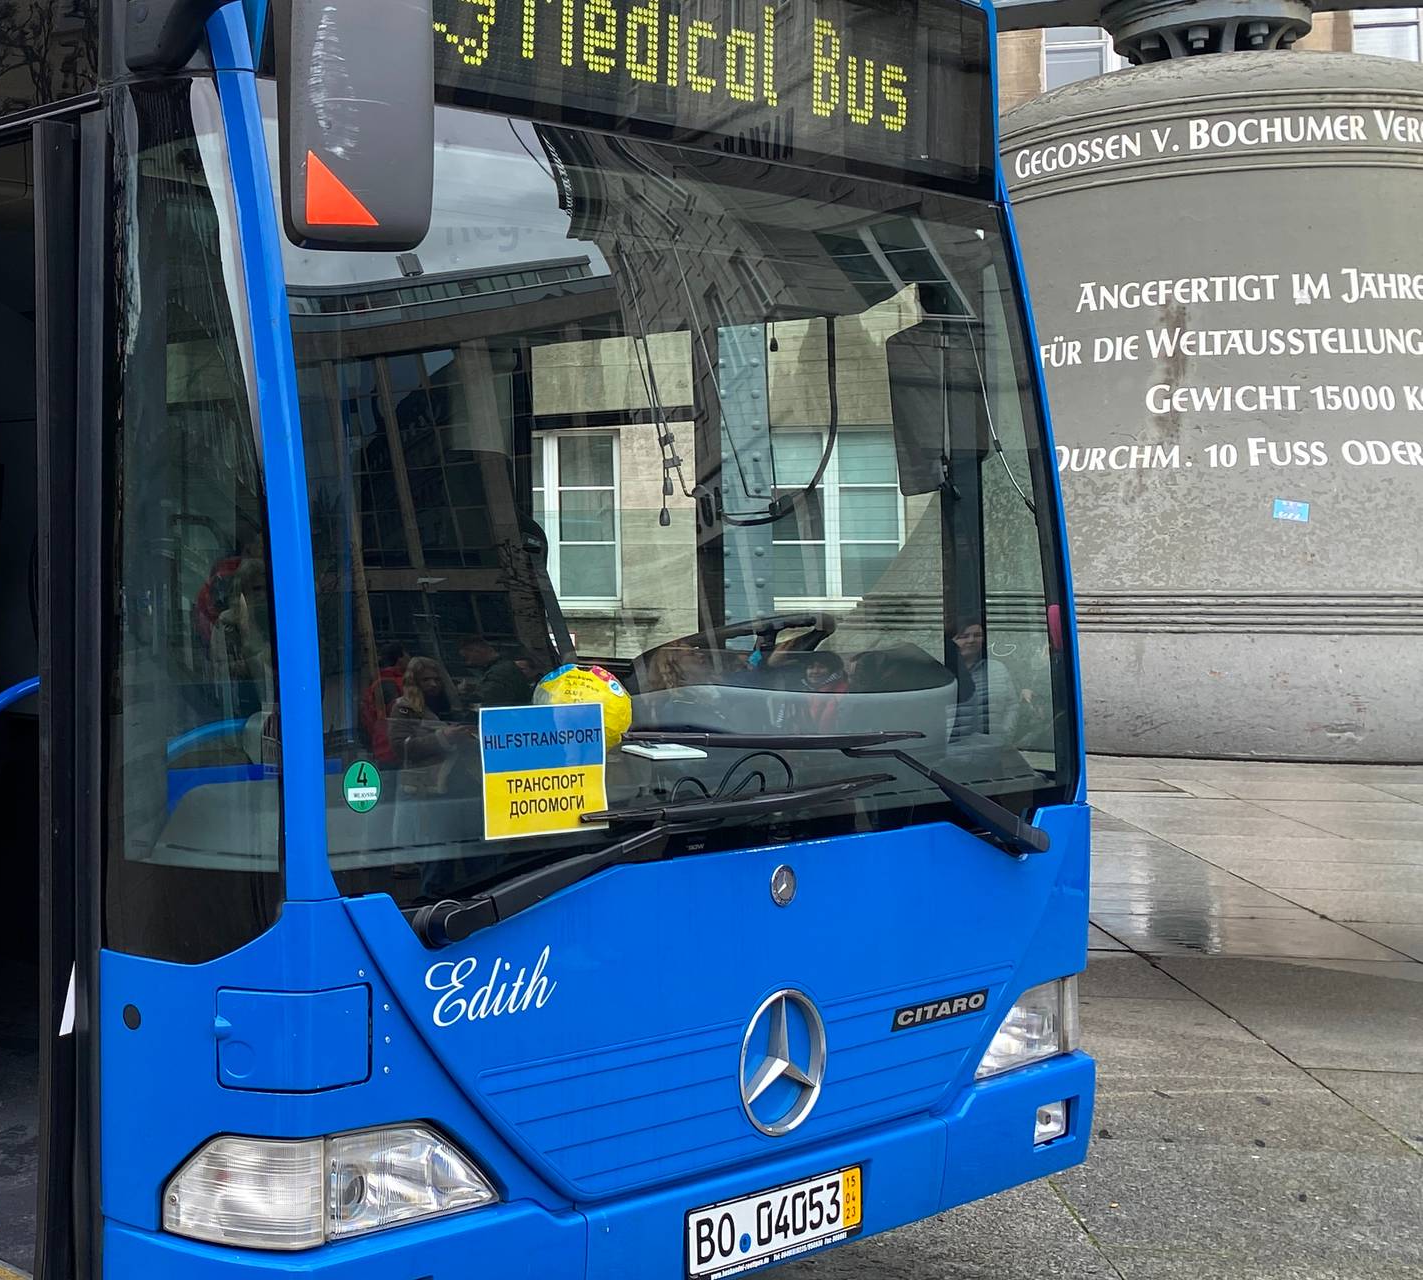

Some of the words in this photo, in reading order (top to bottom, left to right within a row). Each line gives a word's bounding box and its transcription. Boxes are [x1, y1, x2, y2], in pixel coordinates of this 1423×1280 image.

[522, 0, 778, 107] Medical
[812, 18, 908, 132] Bus
[1014, 131, 1141, 179] GEGOSSEN
[1151, 127, 1180, 153] V.
[1189, 114, 1367, 151] BOCHUMER
[1076, 273, 1280, 313] ANGEFERTIGT
[1291, 272, 1332, 302] IM
[1040, 335, 1082, 369] FÜR
[1093, 334, 1139, 363] DIE
[1145, 327, 1423, 360] WELTAUSSTELLUNG
[1145, 384, 1301, 414] GEWICHT
[1309, 385, 1395, 412] 15000
[1405, 385, 1423, 411] K
[1204, 443, 1238, 468] 10
[1247, 436, 1329, 467] FUSS
[484, 727, 602, 751] HILFSTRANSPORT
[356, 763, 368, 786] 4
[506, 772, 586, 795] ТРАНСПОРТ
[509, 795, 585, 819] ДОПОМОГИ
[424, 944, 558, 1027] Edith
[897, 993, 985, 1026] CITARO
[845, 1175, 856, 1188] 15
[845, 1192, 856, 1204] 04
[845, 1207, 856, 1219] 23
[696, 1212, 735, 1265] BO
[756, 1180, 841, 1246] 04053
